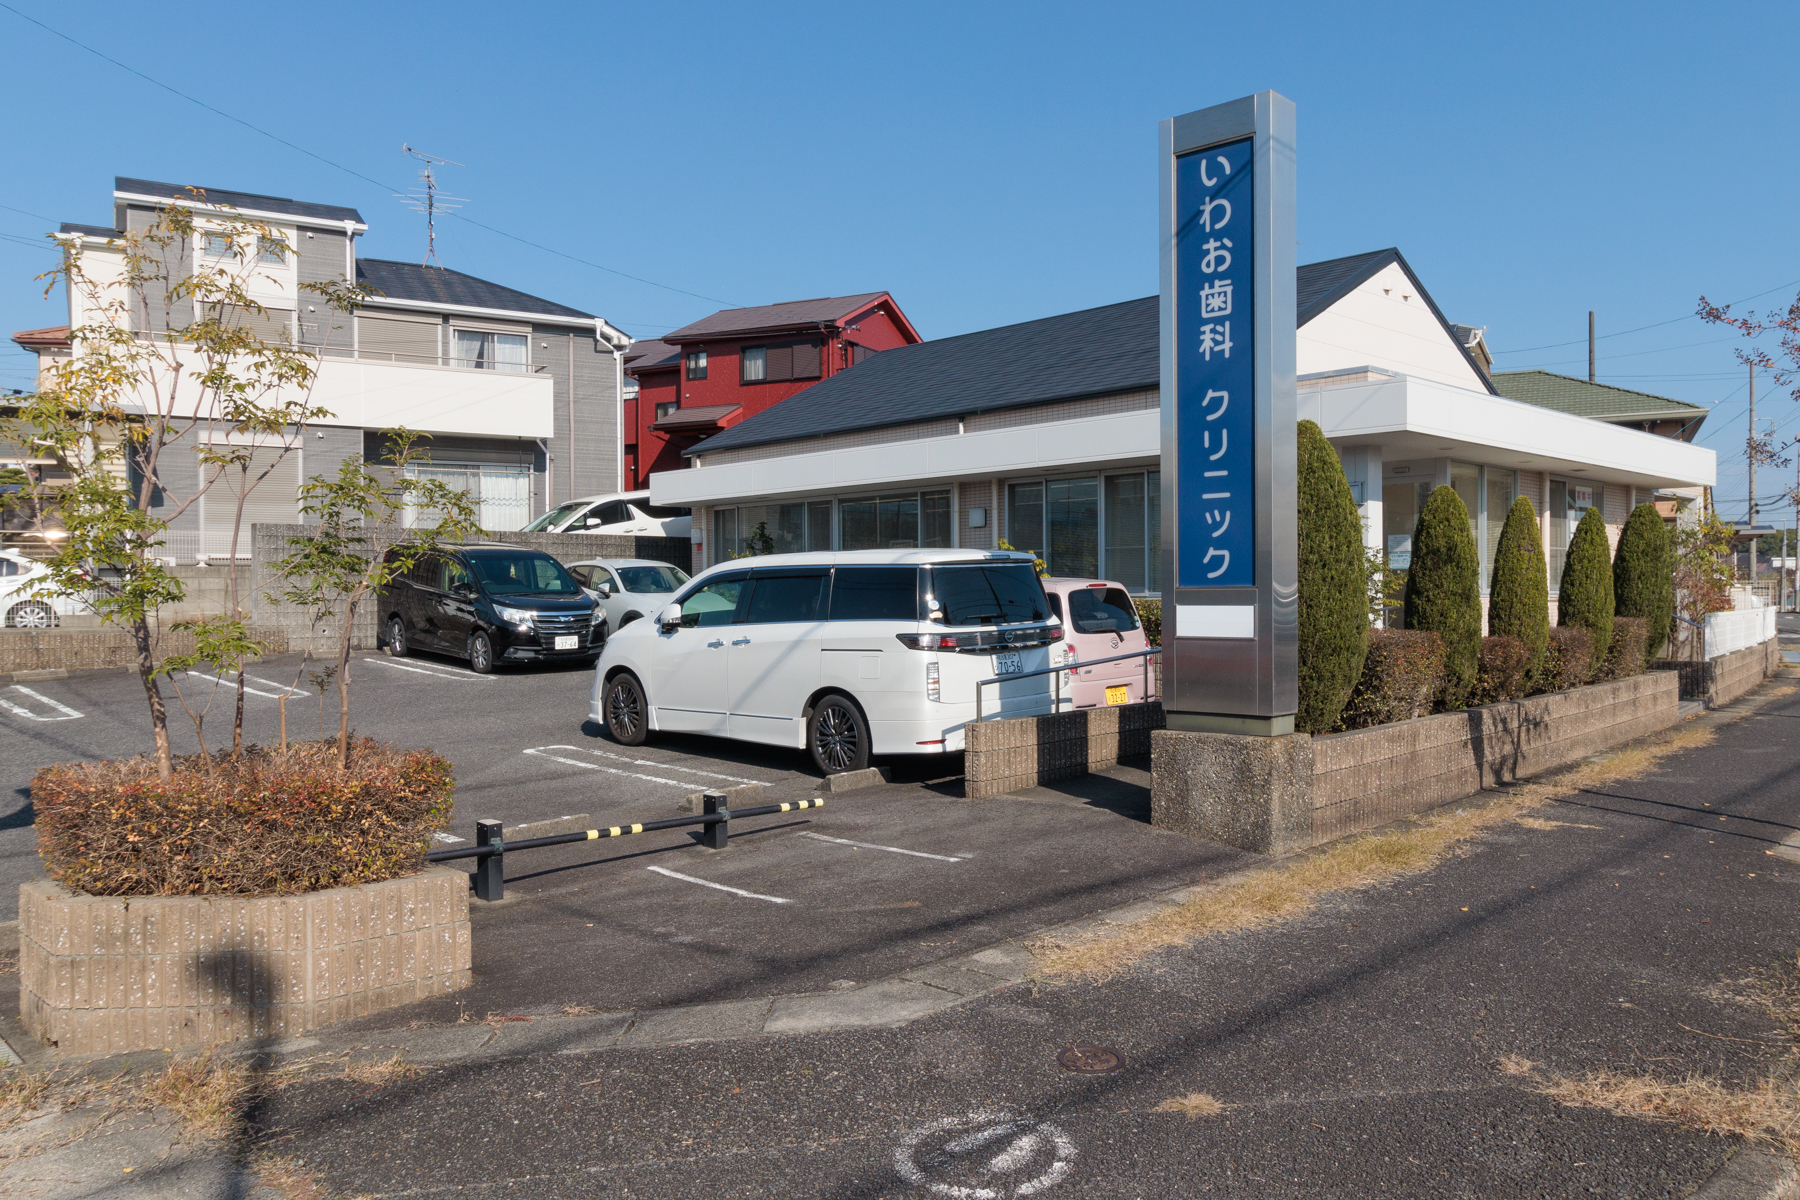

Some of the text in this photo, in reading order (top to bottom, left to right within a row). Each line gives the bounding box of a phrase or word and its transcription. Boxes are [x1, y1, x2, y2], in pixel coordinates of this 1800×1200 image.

[1198, 155, 1234, 579] いわお歯科 クリニック
[999, 660, 1021, 673] 70-56
